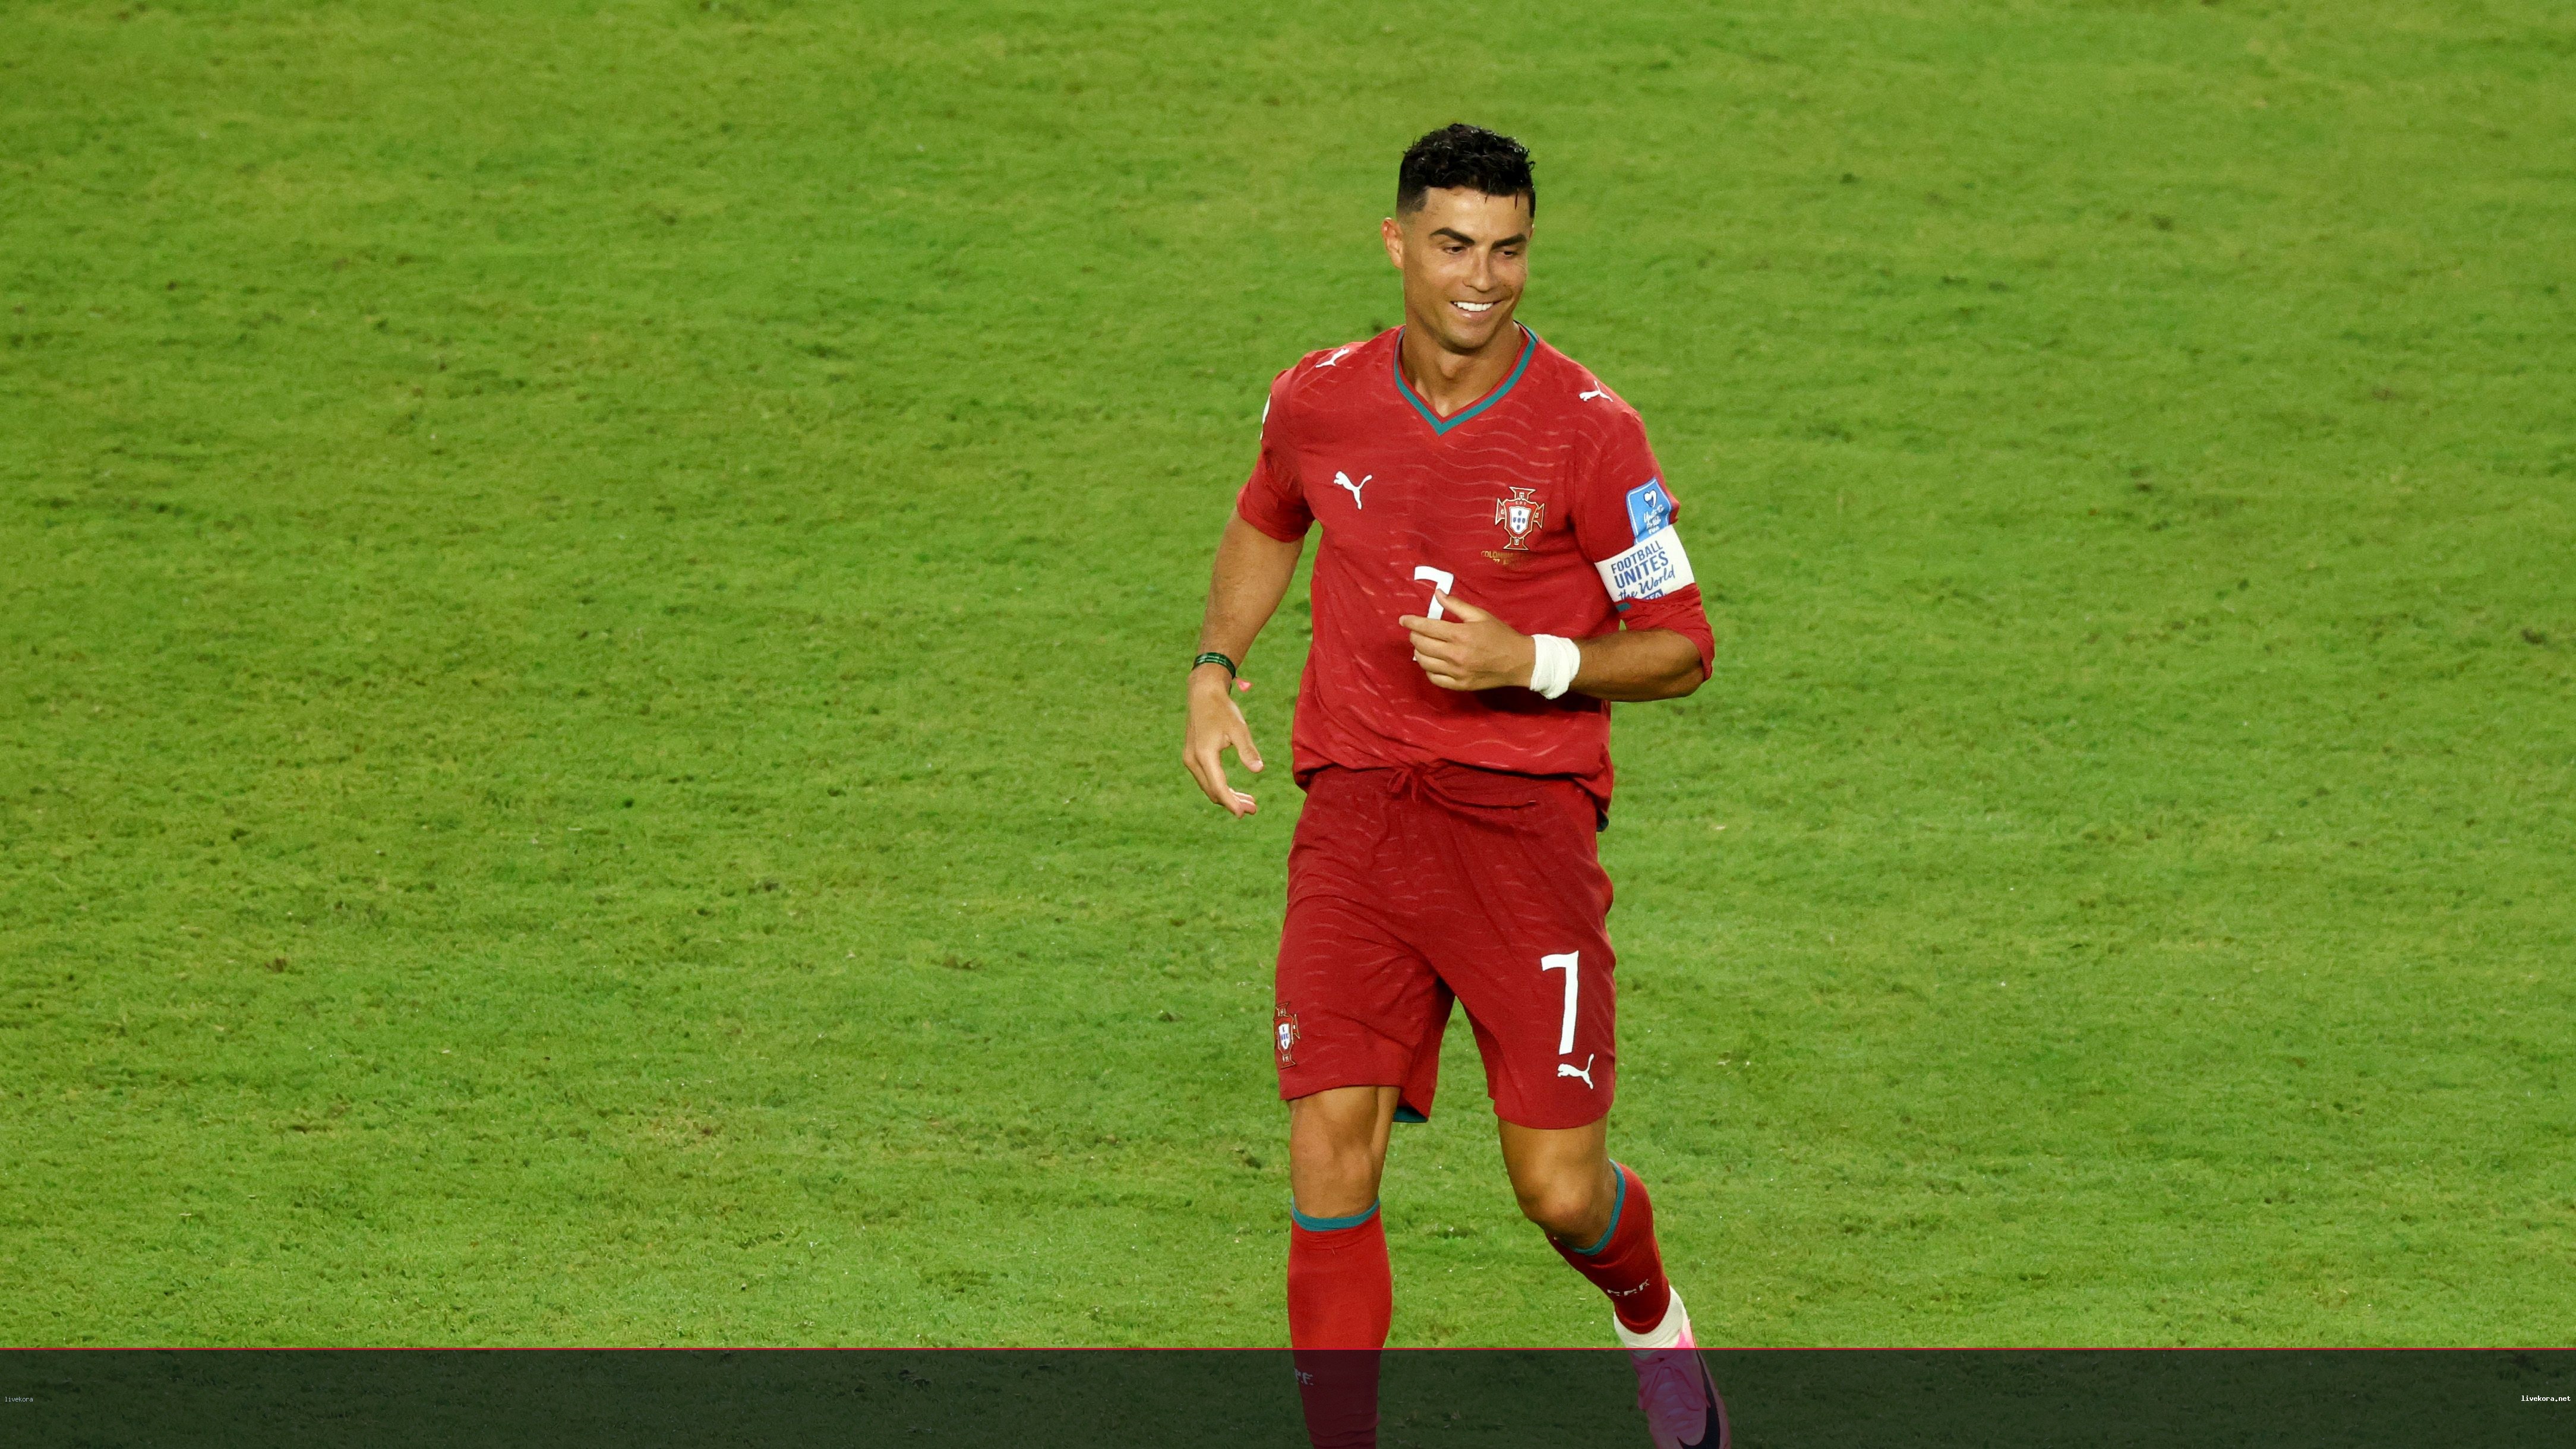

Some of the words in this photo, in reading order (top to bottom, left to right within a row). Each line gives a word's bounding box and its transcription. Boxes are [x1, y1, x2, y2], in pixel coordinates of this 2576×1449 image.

[1611, 540, 1663, 574] FOOTBALL
[1614, 551, 1669, 589] UNITES
[1413, 565, 1454, 621] 7
[1638, 564, 1675, 594] World
[1540, 950, 1579, 1055] 7
